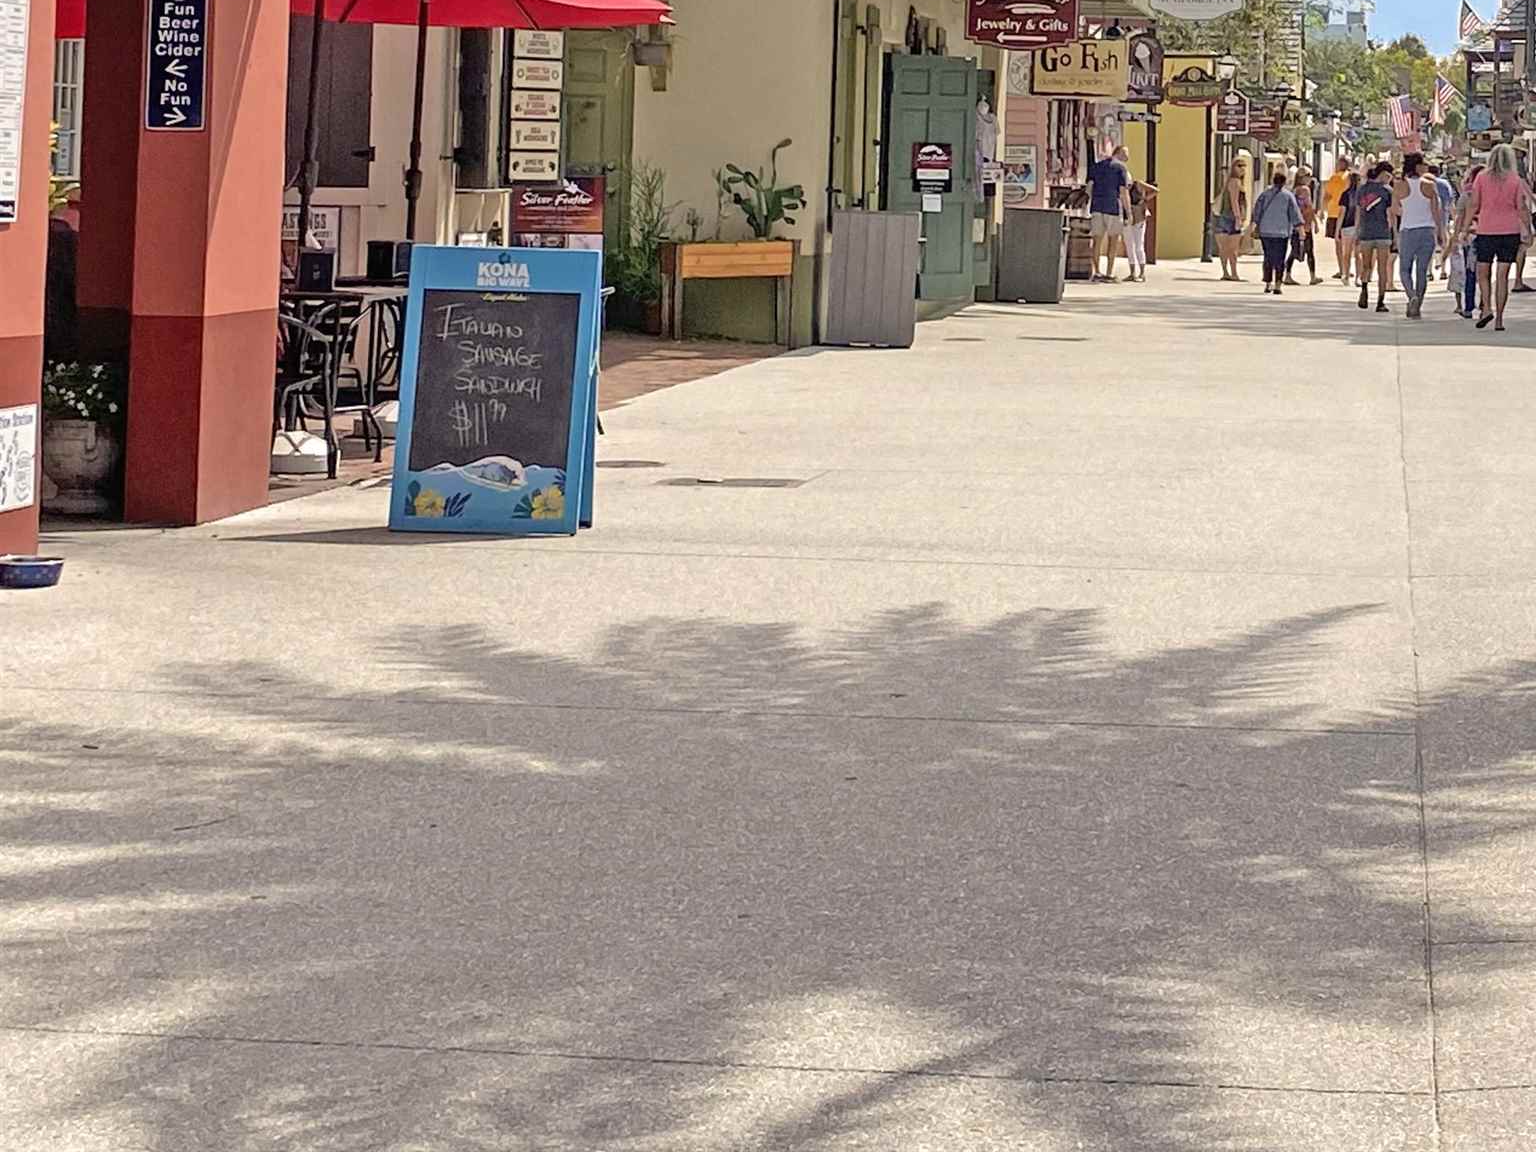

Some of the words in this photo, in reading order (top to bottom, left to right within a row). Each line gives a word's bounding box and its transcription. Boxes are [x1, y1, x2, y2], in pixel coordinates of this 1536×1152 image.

[164, 3, 195, 15] Fun
[159, 16, 200, 28] Beer
[976, 17, 1022, 33] Jewelry
[1025, 19, 1036, 30] &
[1039, 18, 1069, 31] Gifts
[158, 30, 200, 42] Wine
[155, 44, 202, 56] Cider
[1041, 47, 1072, 72] Go
[1080, 43, 1118, 72] Fish
[164, 80, 188, 91] No
[160, 93, 191, 105] Fun
[520, 191, 553, 205] Silver
[478, 262, 529, 277] KONA
[477, 277, 497, 287] BIG
[499, 278, 530, 287] WAVE
[458, 341, 543, 369] SAUSAGE
